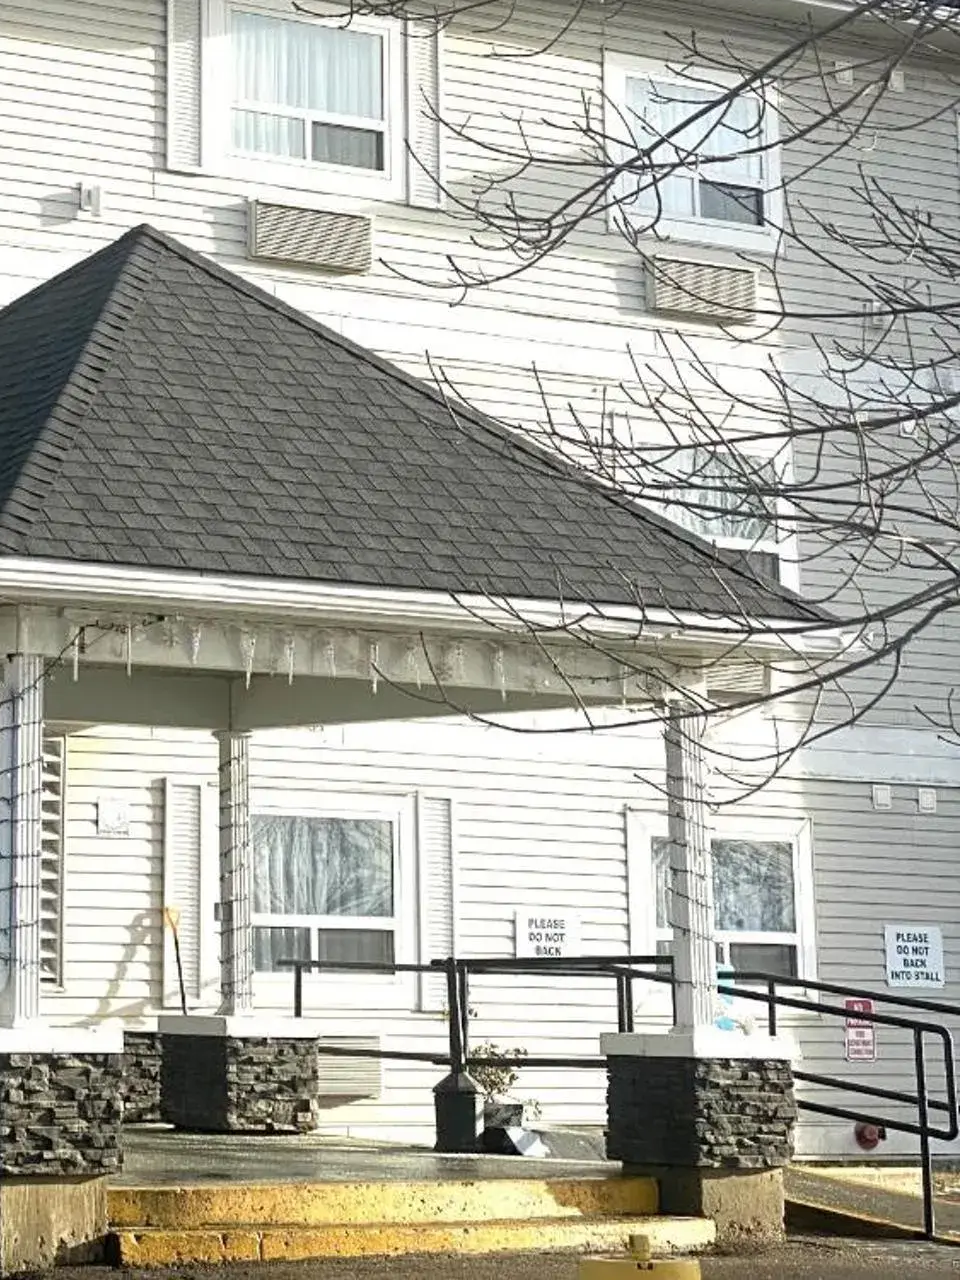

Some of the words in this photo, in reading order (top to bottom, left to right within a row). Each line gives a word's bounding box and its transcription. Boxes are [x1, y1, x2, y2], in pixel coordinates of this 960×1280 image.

[527, 918, 566, 929] PLEASE
[528, 932, 543, 942] DO
[545, 932, 566, 943] NOT
[896, 932, 929, 943] PLEASE
[535, 945, 562, 957] BACK
[896, 945, 910, 955] DO
[911, 946, 930, 956] NOT
[903, 958, 927, 968] BACK
[891, 970, 912, 980] INTO
[914, 970, 942, 982] STALL
